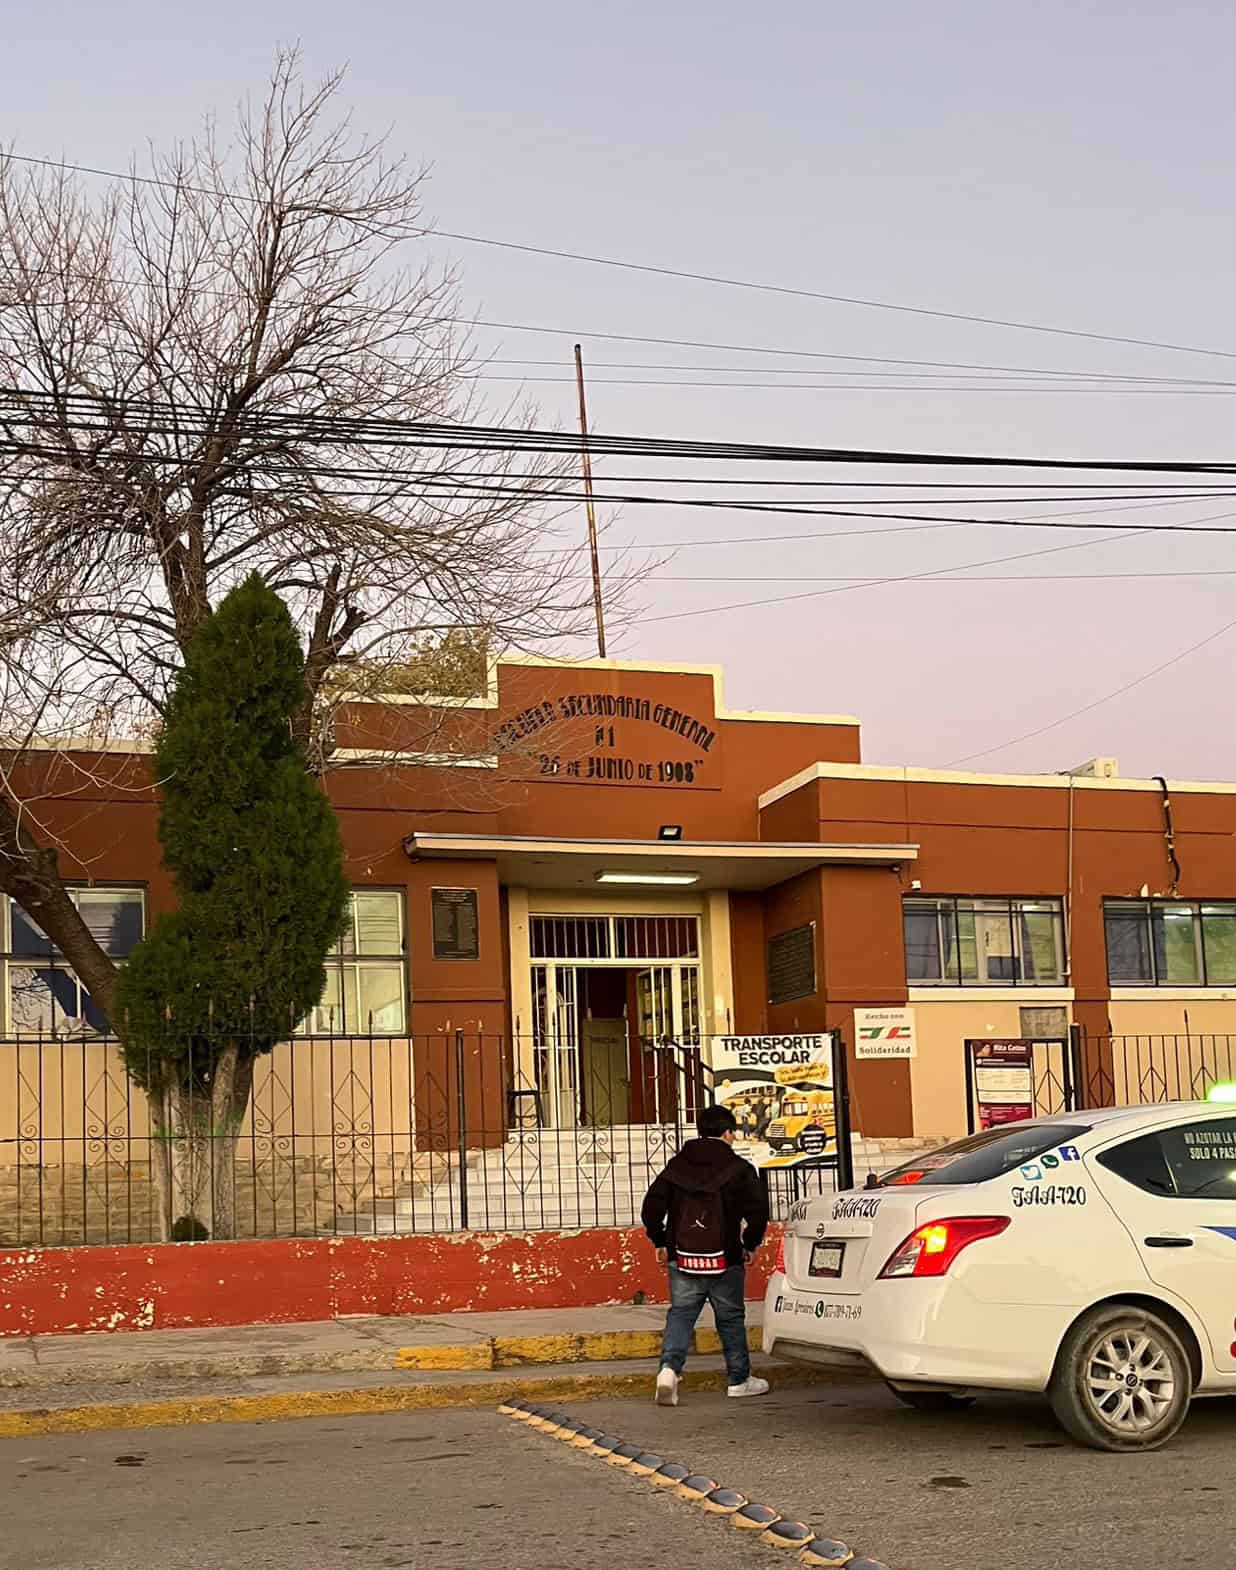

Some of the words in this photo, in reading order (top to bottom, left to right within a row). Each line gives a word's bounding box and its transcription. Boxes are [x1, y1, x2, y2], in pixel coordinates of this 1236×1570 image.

[557, 694, 651, 721] SECUNDARIA
[653, 704, 716, 752] GENERAL
[587, 757, 634, 780] JUNIO
[638, 763, 654, 781] DE
[721, 1035, 823, 1051] TRANSPORTE
[739, 1051, 811, 1066] ESCOLAR
[1195, 1132, 1223, 1145] AZOTAR
[1222, 1131, 1233, 1144] LA
[1189, 1147, 1211, 1160] SOLO
[1211, 1147, 1219, 1160] 4
